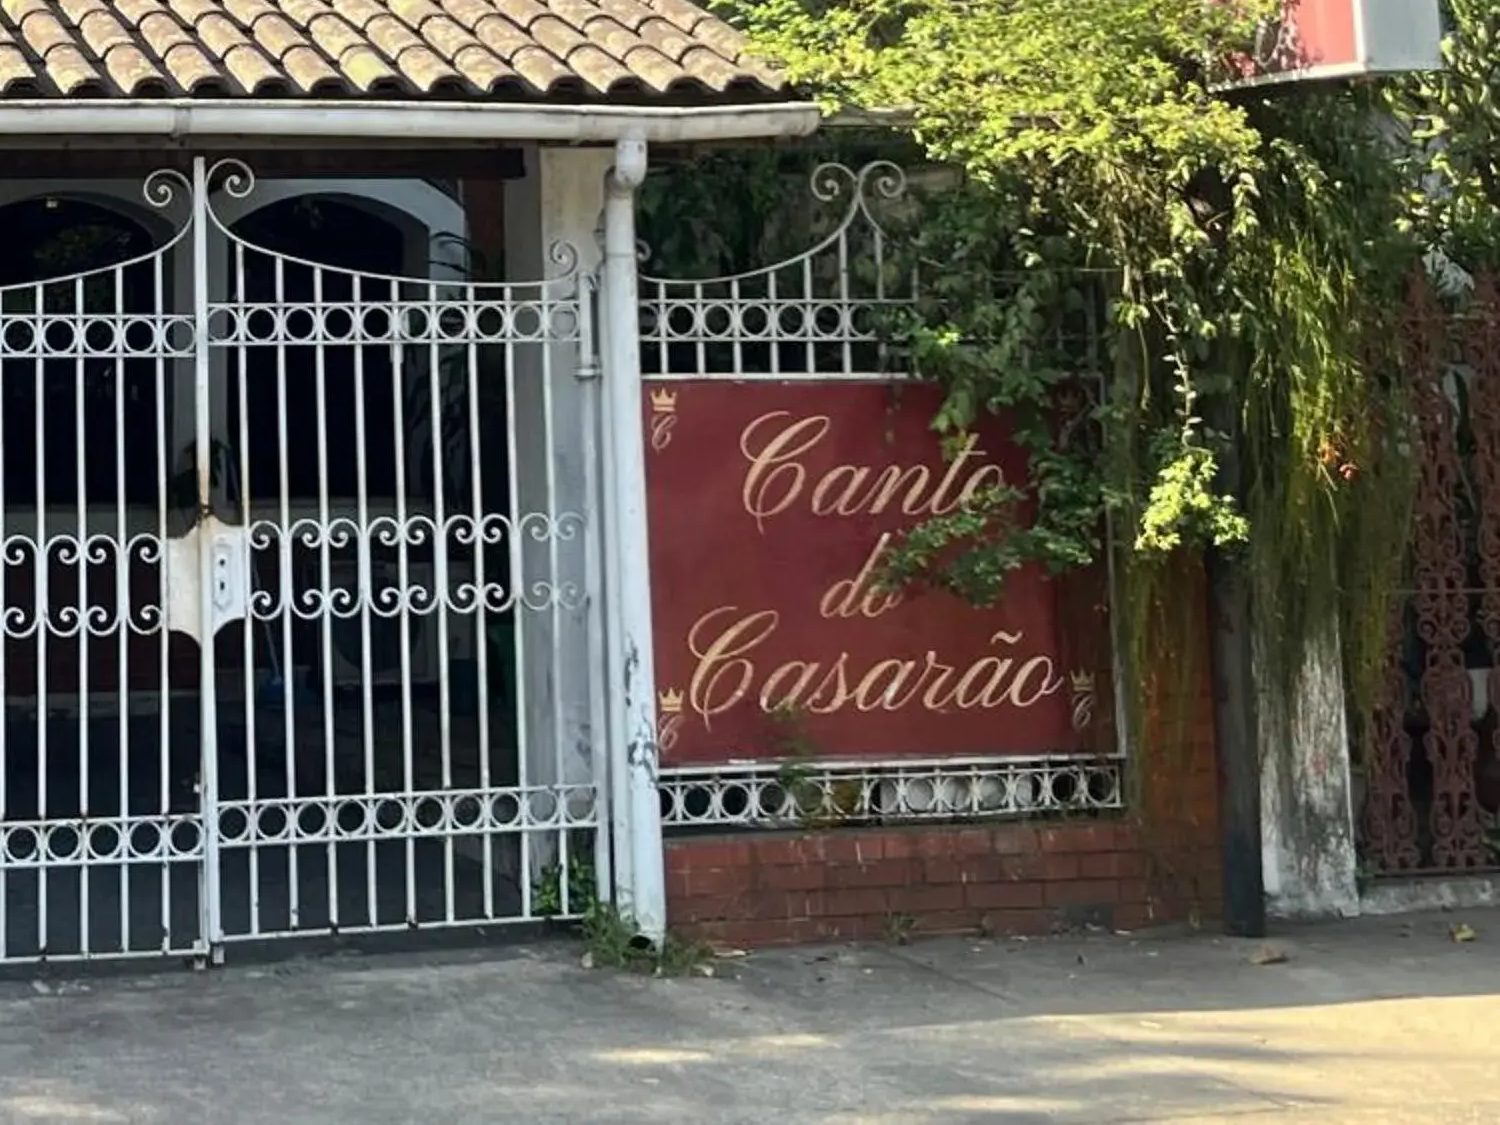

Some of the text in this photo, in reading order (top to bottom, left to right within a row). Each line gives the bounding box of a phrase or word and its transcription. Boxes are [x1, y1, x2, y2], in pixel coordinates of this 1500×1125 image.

[740, 410, 1003, 535] Canto
[819, 532, 902, 618] do
[687, 606, 1063, 733] Casarão
